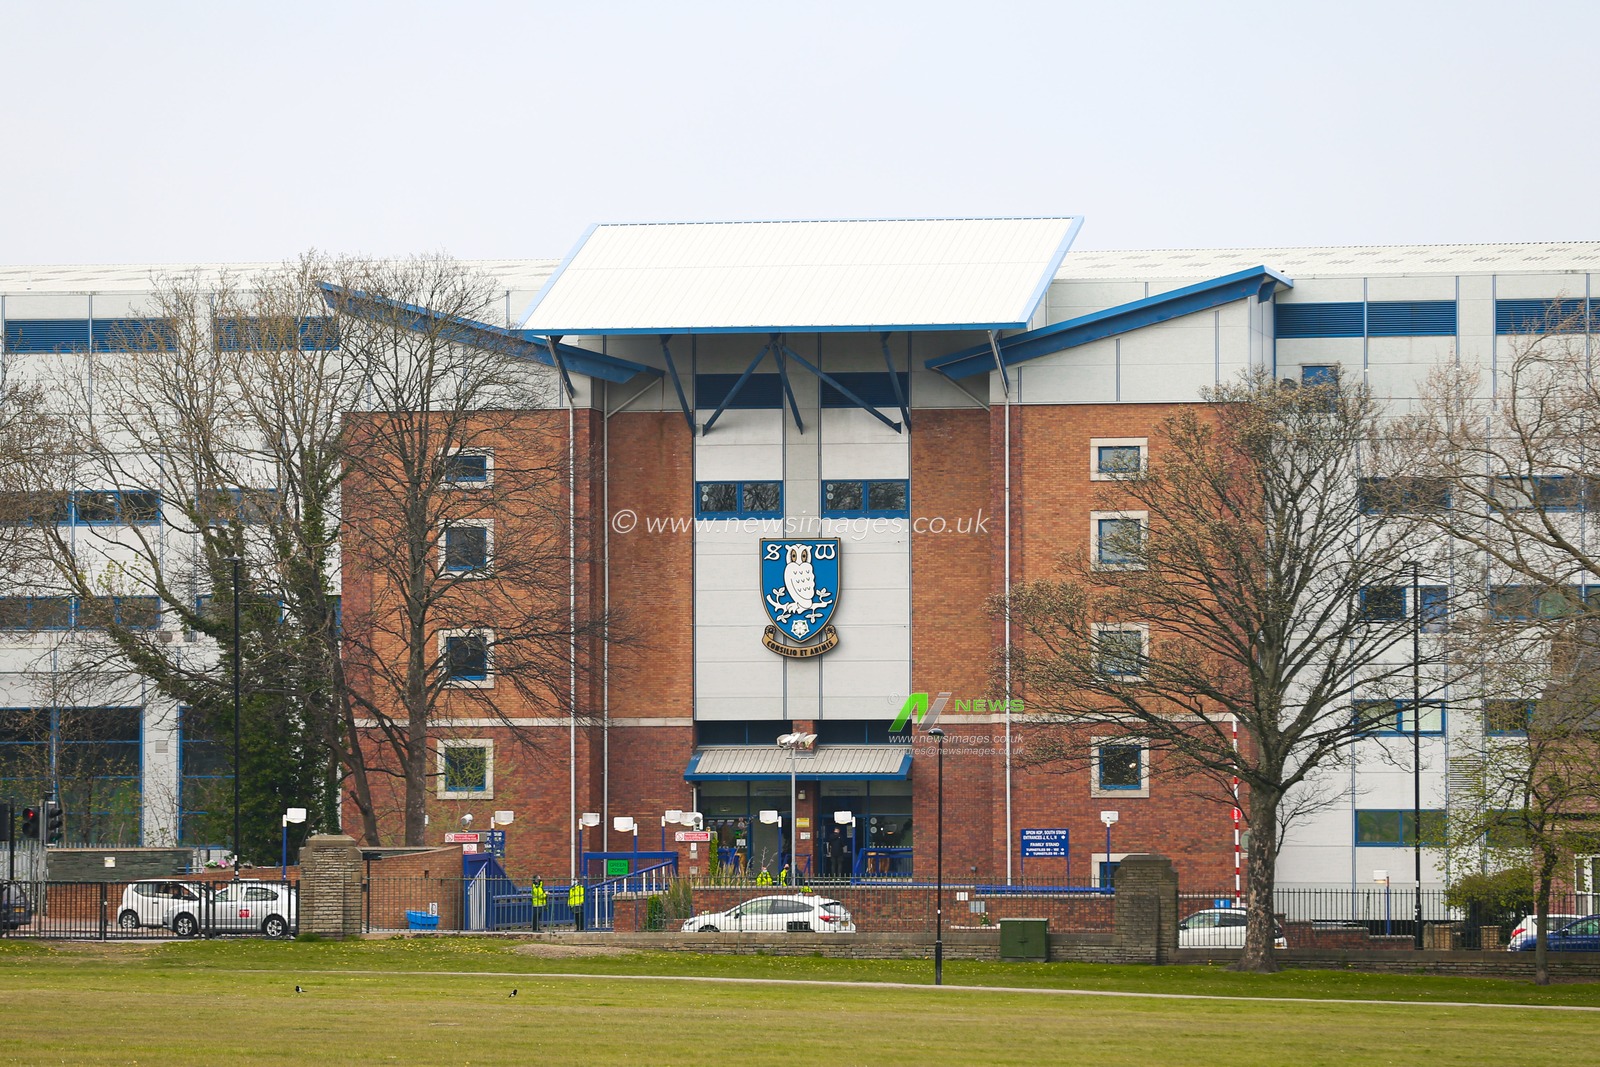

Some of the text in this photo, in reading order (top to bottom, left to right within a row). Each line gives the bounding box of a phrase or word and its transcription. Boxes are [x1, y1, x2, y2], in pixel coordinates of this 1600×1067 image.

[764, 543, 782, 560] S
[766, 640, 834, 657] CONSILIO ET ANIMIS
